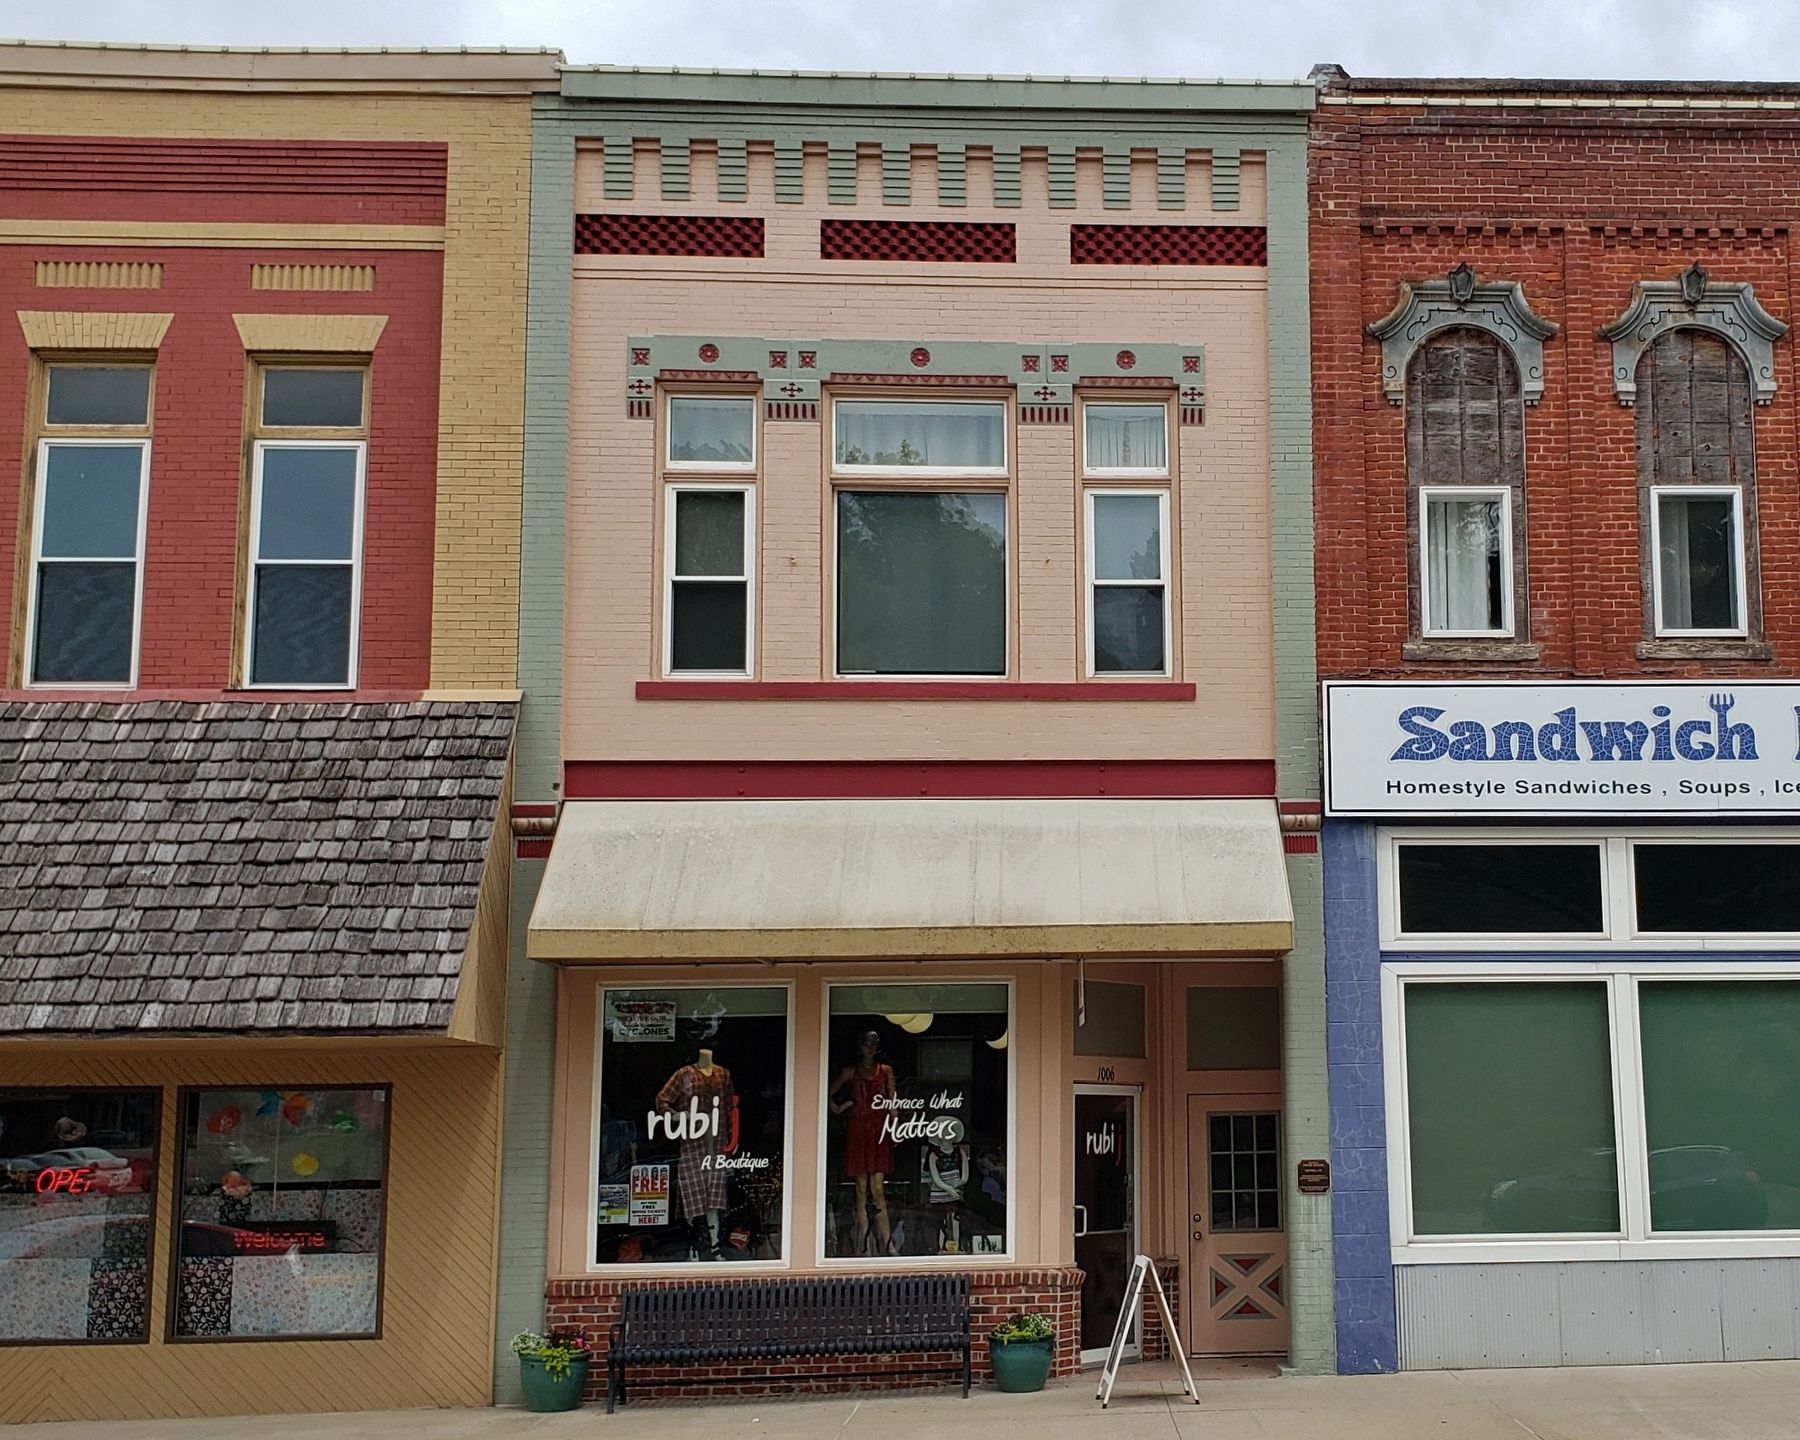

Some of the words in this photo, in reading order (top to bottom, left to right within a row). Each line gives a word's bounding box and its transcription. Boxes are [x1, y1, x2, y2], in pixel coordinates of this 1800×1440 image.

[1389, 693, 1760, 761] Sandwich
[1386, 780, 1506, 797] Homestyle
[1097, 1066, 1115, 1081] 1006
[871, 1091, 925, 1110] Embrace
[929, 1089, 964, 1109] What
[647, 1095, 720, 1140] rubi
[878, 1111, 959, 1145] Matters
[1087, 1122, 1115, 1155] rubi
[701, 1155, 712, 1170] A
[715, 1151, 769, 1172] Boutique
[632, 1176, 668, 1192] FREE
[233, 1228, 325, 1248] Welcome
